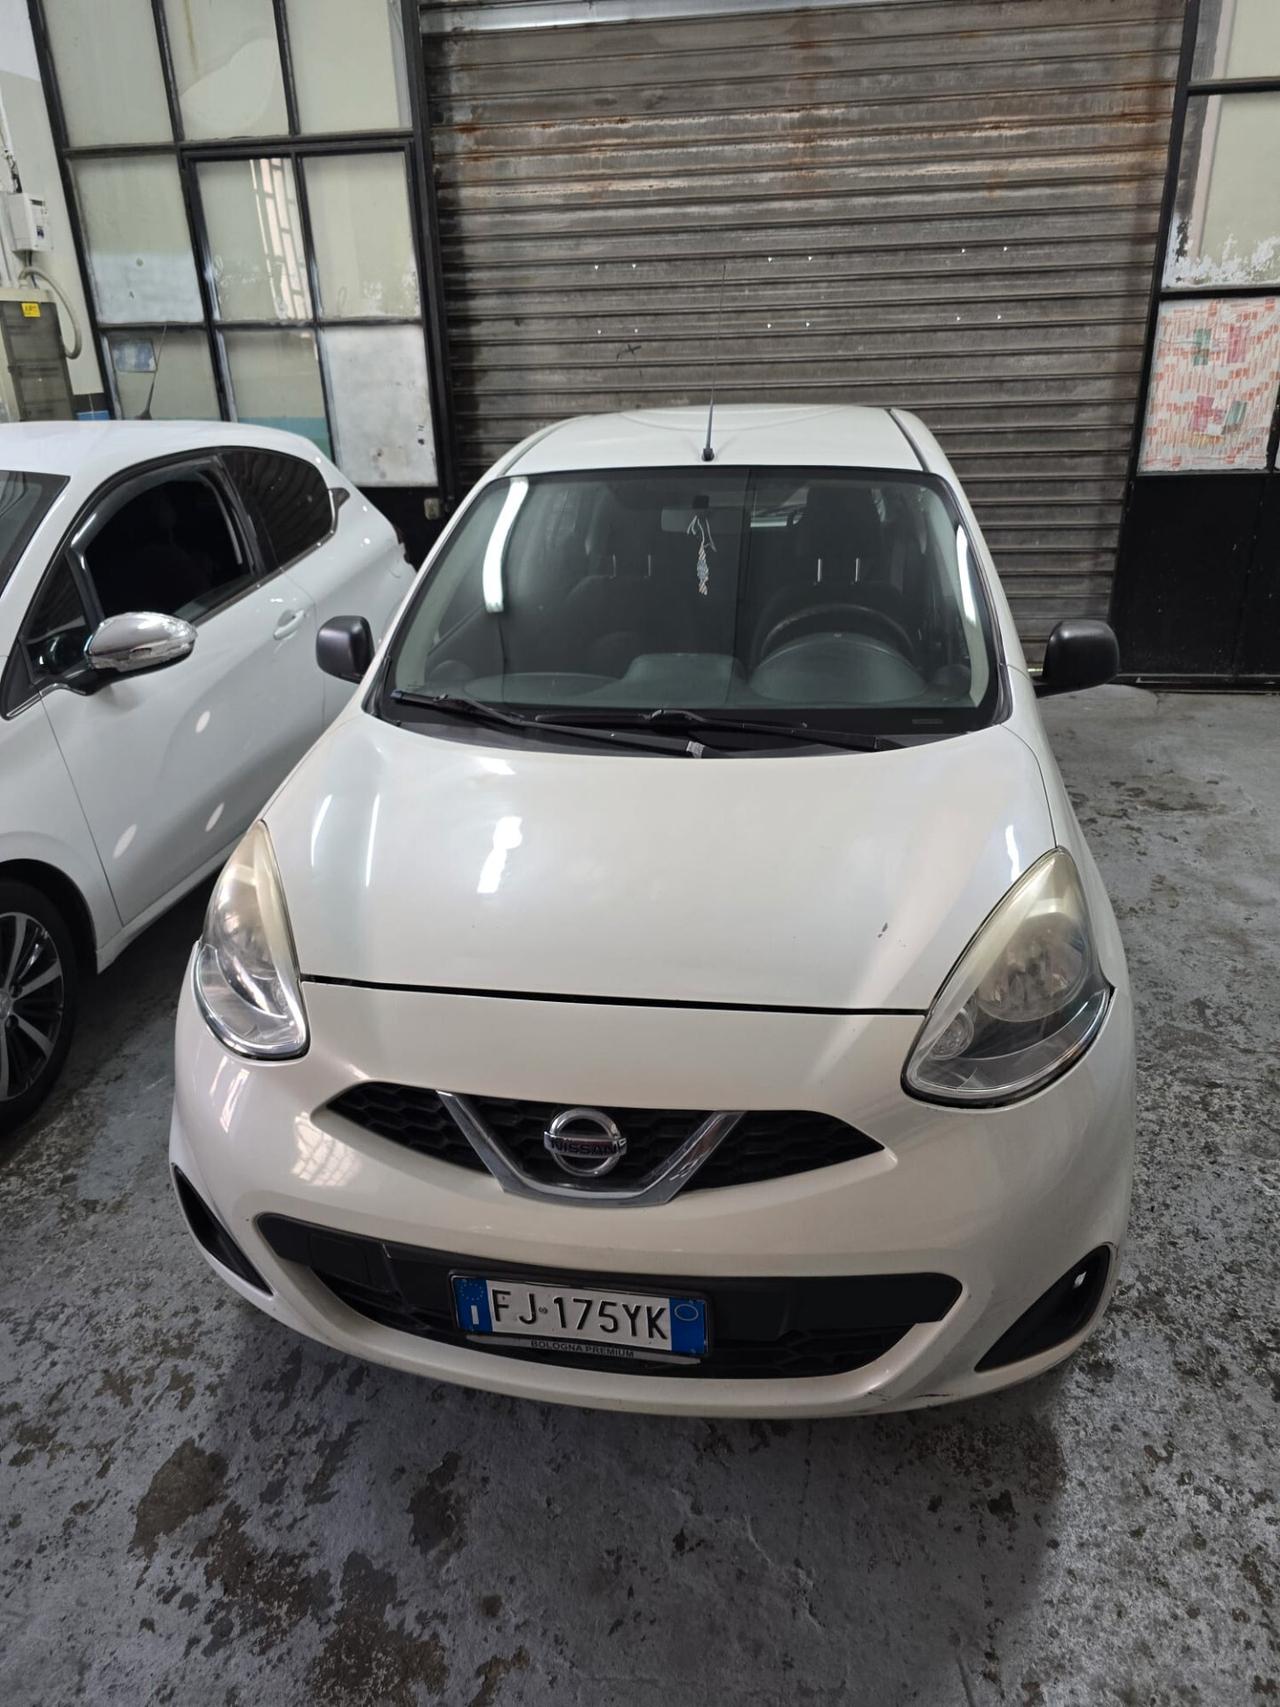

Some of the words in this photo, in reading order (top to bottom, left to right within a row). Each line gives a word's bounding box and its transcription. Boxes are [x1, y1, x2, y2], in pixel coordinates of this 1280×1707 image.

[550, 1140, 618, 1154] NISSAN
[531, 1340, 583, 1352] BOLOGNA
[585, 1343, 635, 1358] PREMIUM
